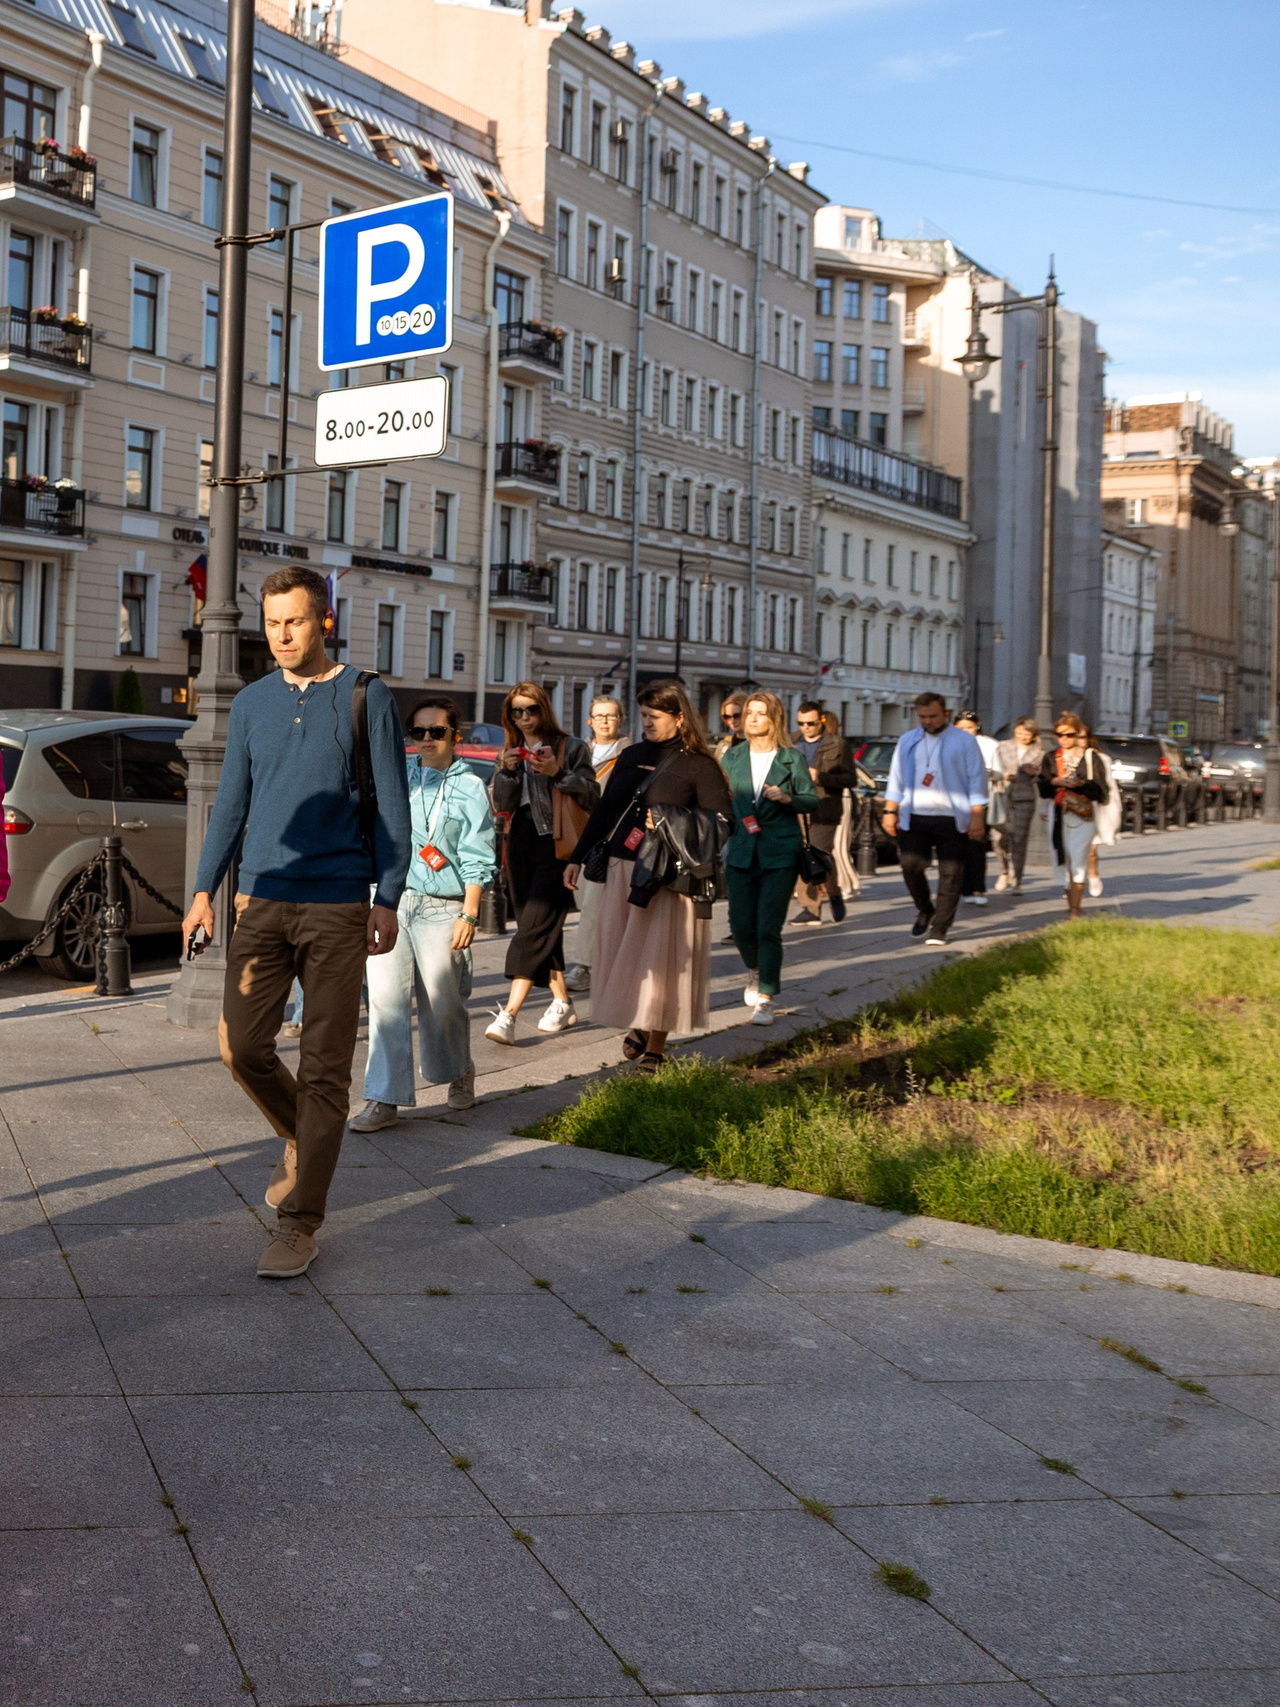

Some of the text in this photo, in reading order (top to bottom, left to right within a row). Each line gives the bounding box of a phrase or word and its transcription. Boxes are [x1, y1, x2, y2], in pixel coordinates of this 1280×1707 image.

[355, 222, 426, 347] P
[381, 310, 433, 331] 10 15 20
[325, 410, 434, 442] 8.00-20.00
[172, 527, 205, 544] ОТЕЛЬ
[238, 538, 310, 560] OUTIQUE HOTEL
